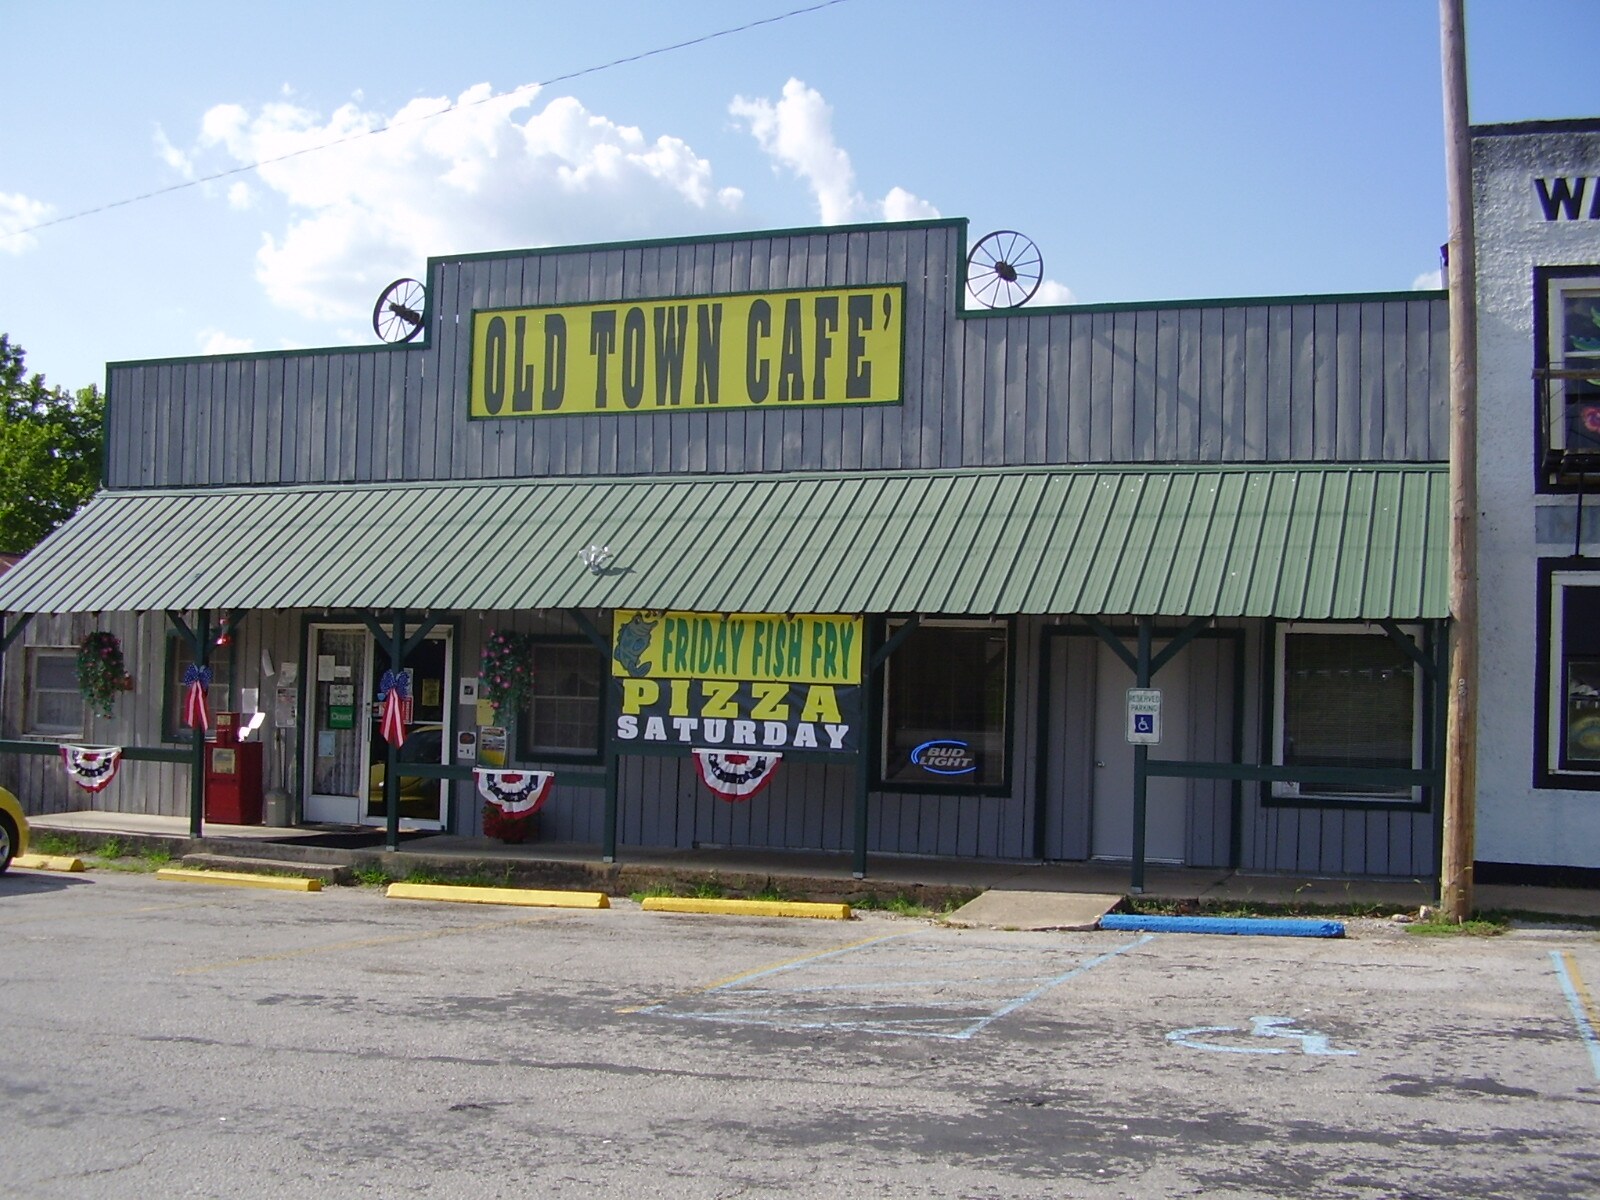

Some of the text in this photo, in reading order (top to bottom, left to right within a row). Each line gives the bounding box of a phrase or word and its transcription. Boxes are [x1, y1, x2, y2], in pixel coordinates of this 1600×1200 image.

[1534, 177, 1600, 221] W
[484, 293, 892, 415] OLD TOWN CAFE'
[662, 618, 854, 679] FRIDAY FISH FRY
[622, 679, 842, 723] PIZZA
[1128, 694, 1160, 703] RESERVED
[1130, 704, 1158, 712] PARKING
[617, 715, 849, 749] SATURDAY
[919, 756, 973, 767] LIGHT
[927, 747, 966, 757] BUD
